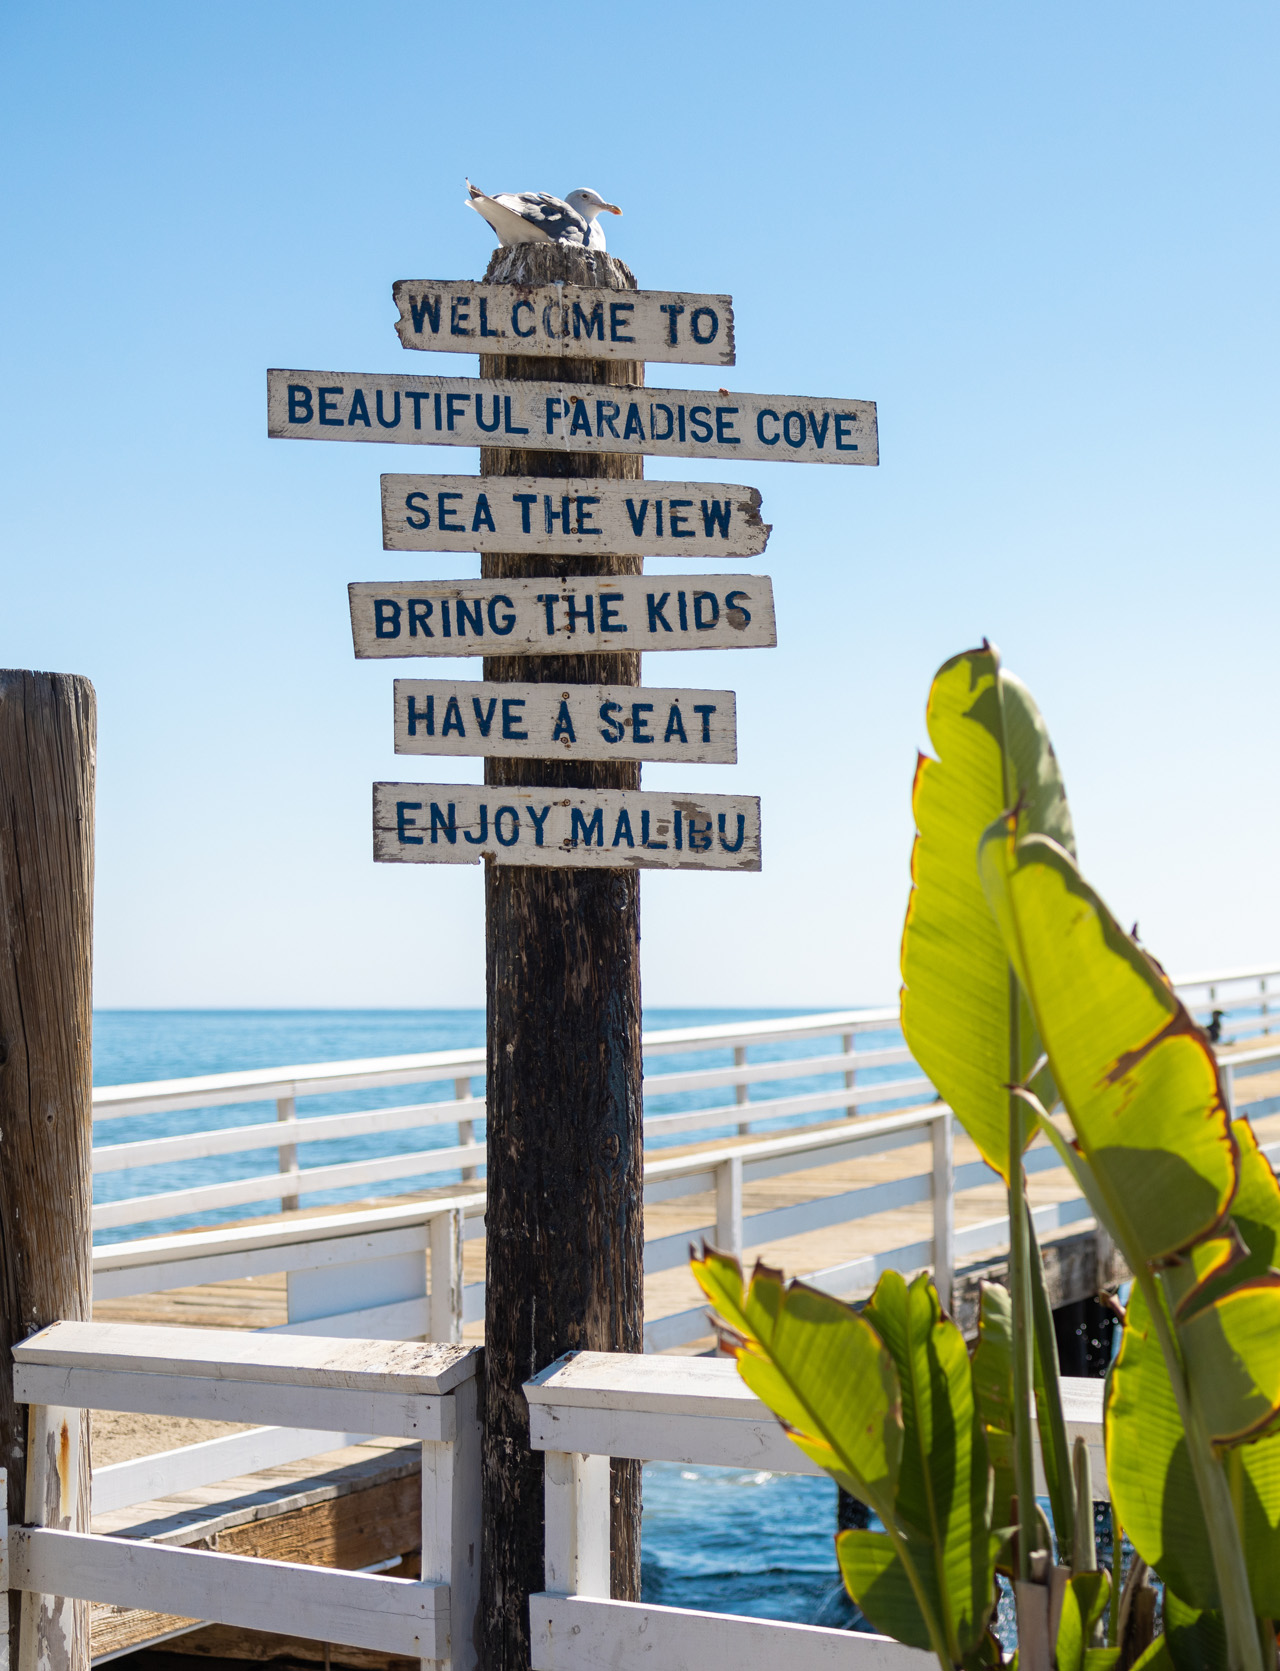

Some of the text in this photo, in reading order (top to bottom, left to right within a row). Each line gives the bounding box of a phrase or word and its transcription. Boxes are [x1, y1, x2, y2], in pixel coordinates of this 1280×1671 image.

[408, 294, 719, 345] WELCOME TO
[287, 384, 859, 451] BEAUTIFUL PARADISE COVE
[405, 492, 732, 539] SEA THE VIEW
[374, 590, 752, 639] BRING THE KIDS
[407, 695, 717, 744] HAVE A SEAT
[396, 801, 745, 853] ENJOY MALIBU
